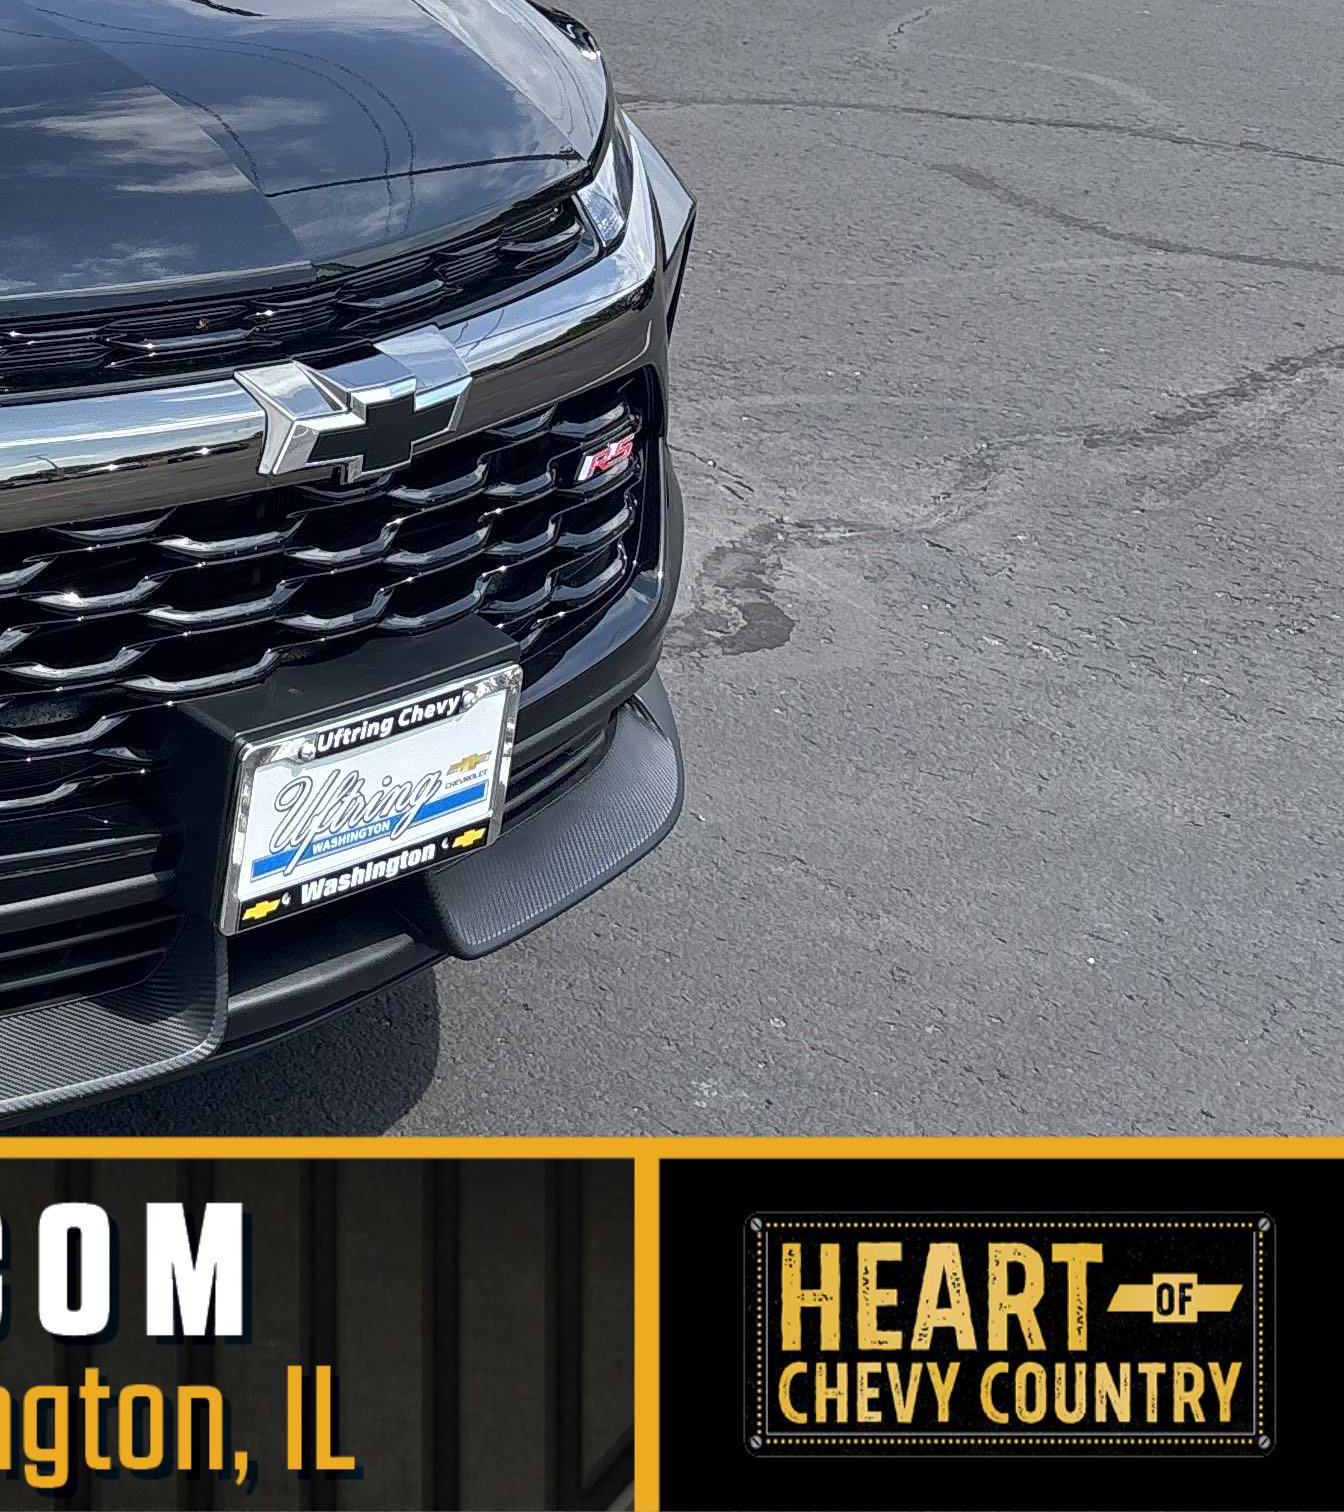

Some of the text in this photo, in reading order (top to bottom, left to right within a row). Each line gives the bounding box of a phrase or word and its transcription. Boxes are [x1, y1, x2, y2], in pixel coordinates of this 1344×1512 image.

[318, 695, 461, 753] Uftring Chevy
[269, 768, 442, 876] Uftring
[312, 819, 392, 855] WASHINGTON
[301, 842, 436, 905] Washington
